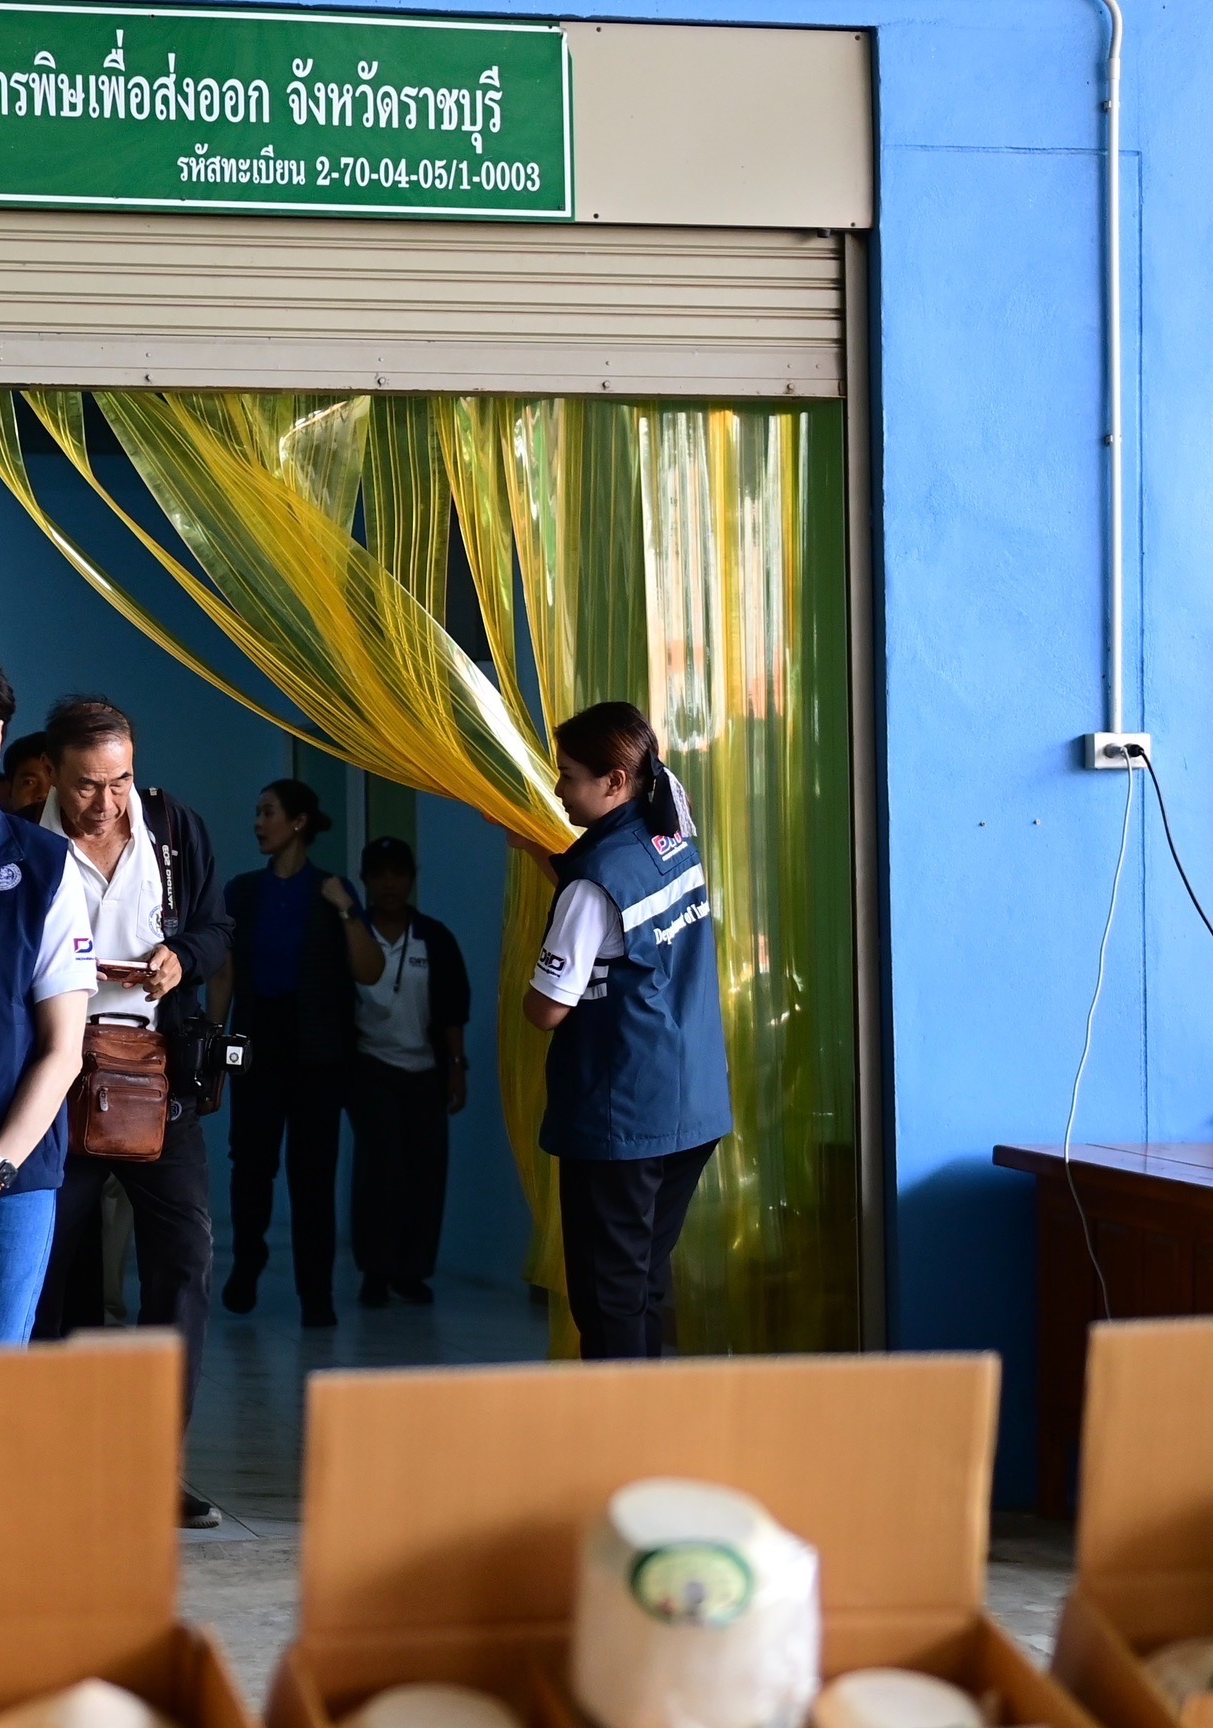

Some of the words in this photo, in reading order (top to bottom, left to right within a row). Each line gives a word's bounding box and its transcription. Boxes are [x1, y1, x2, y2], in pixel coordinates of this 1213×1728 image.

[286, 57, 503, 154] จังหวัดราชบุรี
[176, 143, 306, 187] รหัสทะเบียน
[316, 156, 541, 192] 2-70-04-05/1-0003
